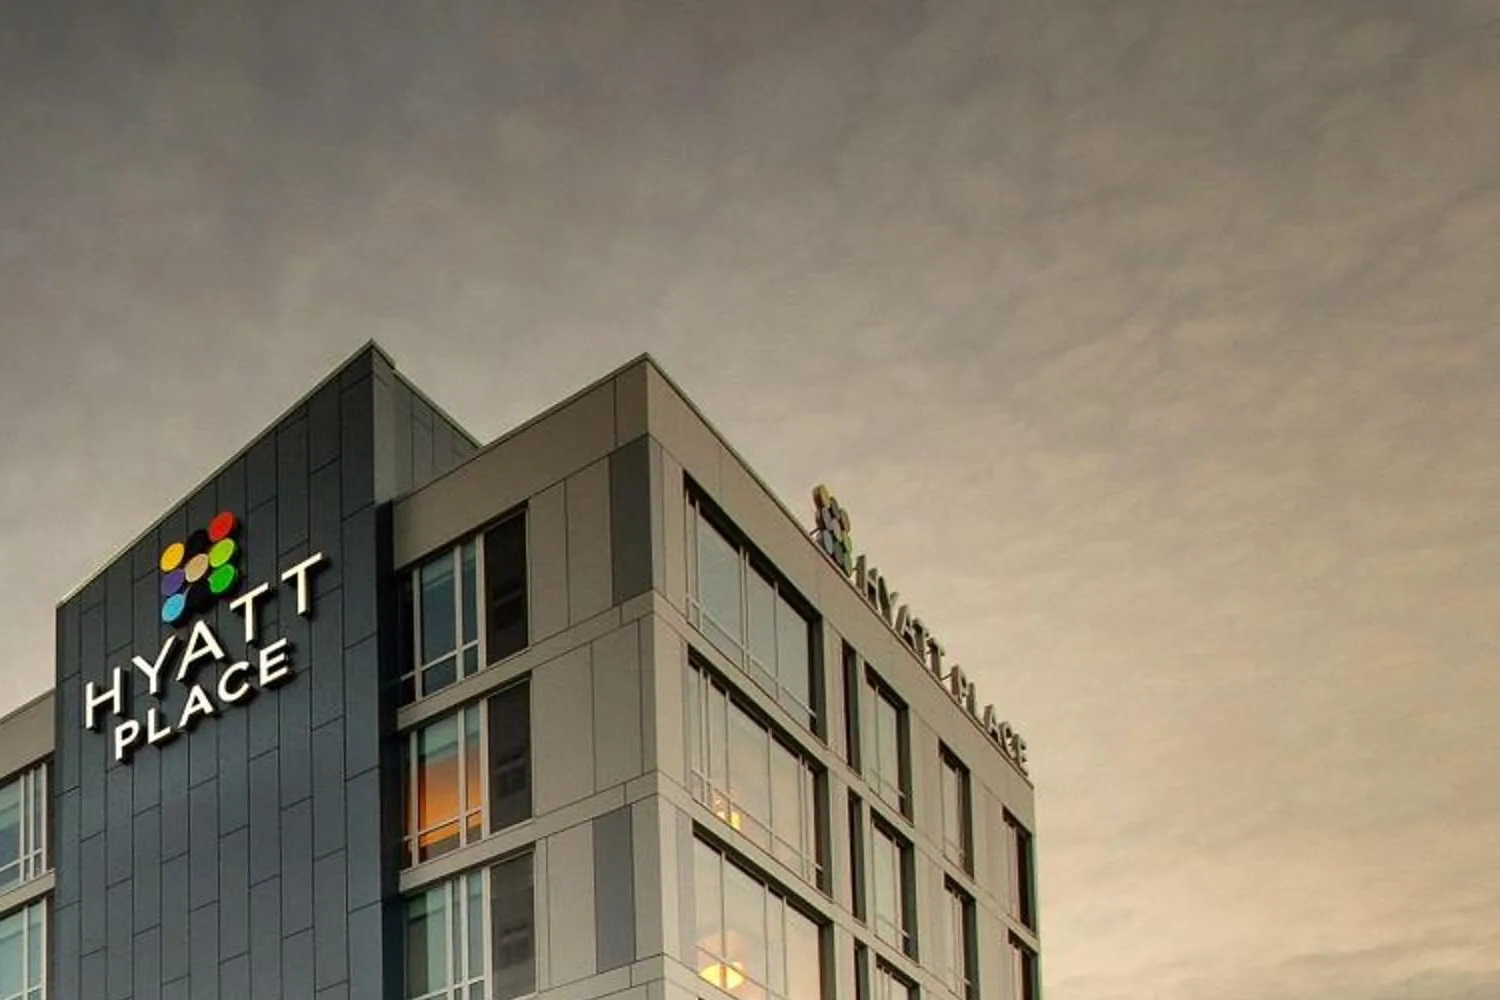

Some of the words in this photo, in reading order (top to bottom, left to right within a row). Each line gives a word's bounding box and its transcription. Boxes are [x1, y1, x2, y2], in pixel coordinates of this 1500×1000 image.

[85, 552, 323, 730] HYATT
[854, 555, 946, 681] HYATT
[115, 637, 288, 761] PLACE
